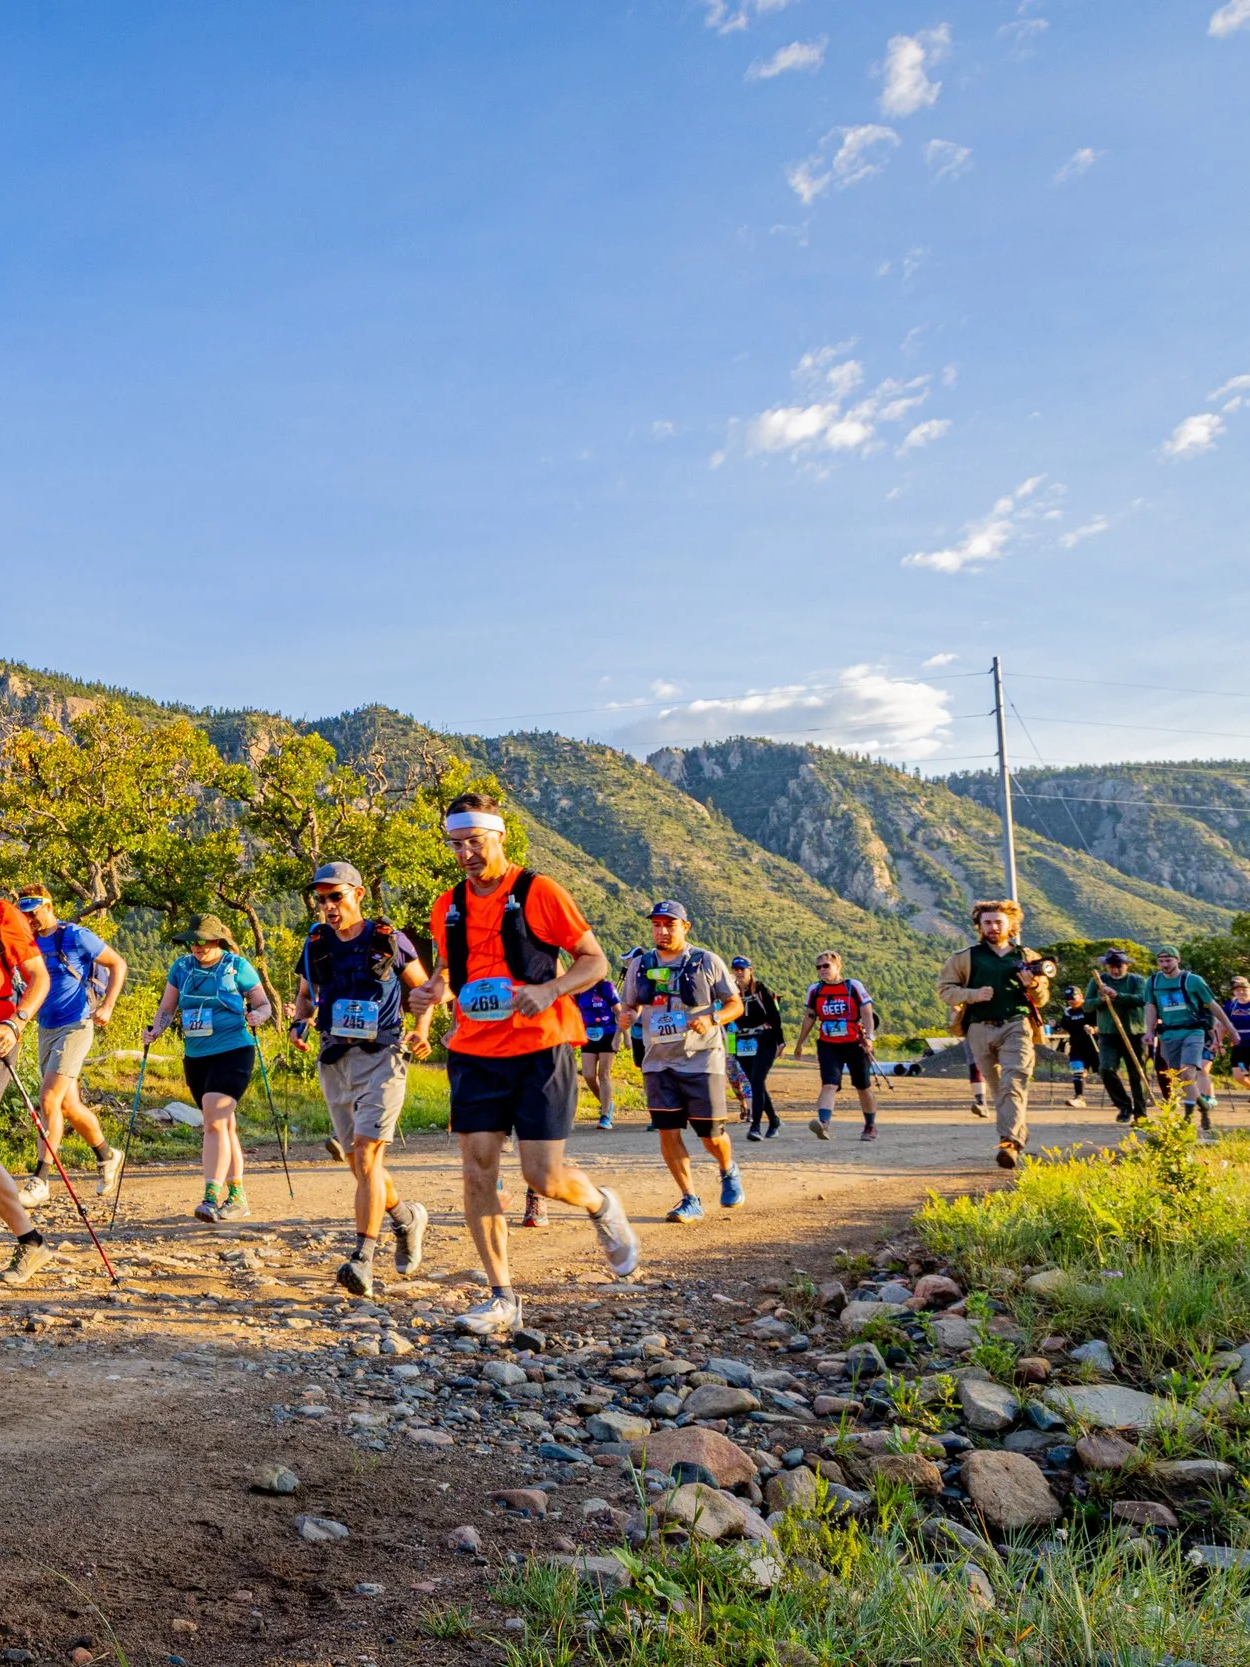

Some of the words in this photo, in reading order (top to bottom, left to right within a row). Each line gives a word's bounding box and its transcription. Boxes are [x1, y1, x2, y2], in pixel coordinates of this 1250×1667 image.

[470, 994, 500, 1012] 269
[822, 1003, 847, 1016] BEEF
[342, 1014, 365, 1029] 245
[657, 1023, 678, 1036] 201
